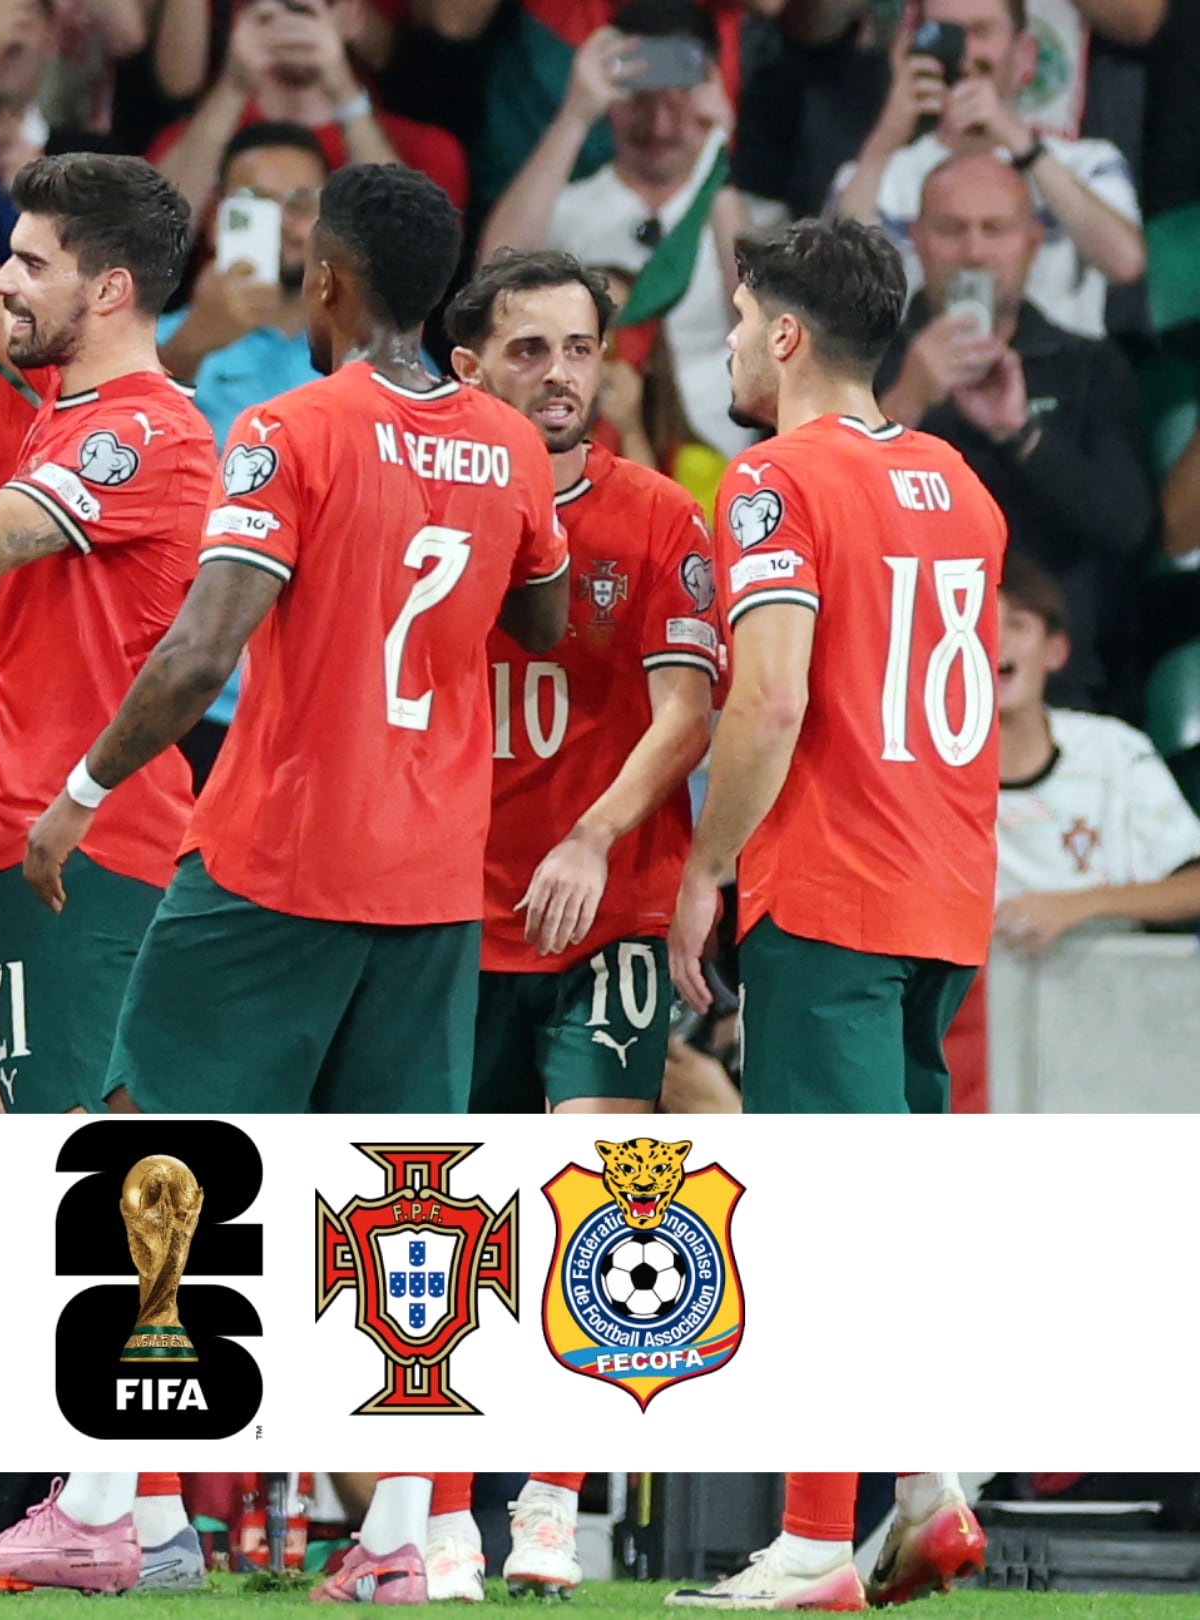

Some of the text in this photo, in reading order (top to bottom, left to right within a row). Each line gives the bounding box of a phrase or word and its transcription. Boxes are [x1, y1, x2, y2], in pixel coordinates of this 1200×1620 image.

[888, 468, 952, 512] NETO
[384, 524, 473, 731] 2
[880, 555, 995, 767] 18
[491, 661, 569, 759] 10
[584, 942, 658, 1029] 10
